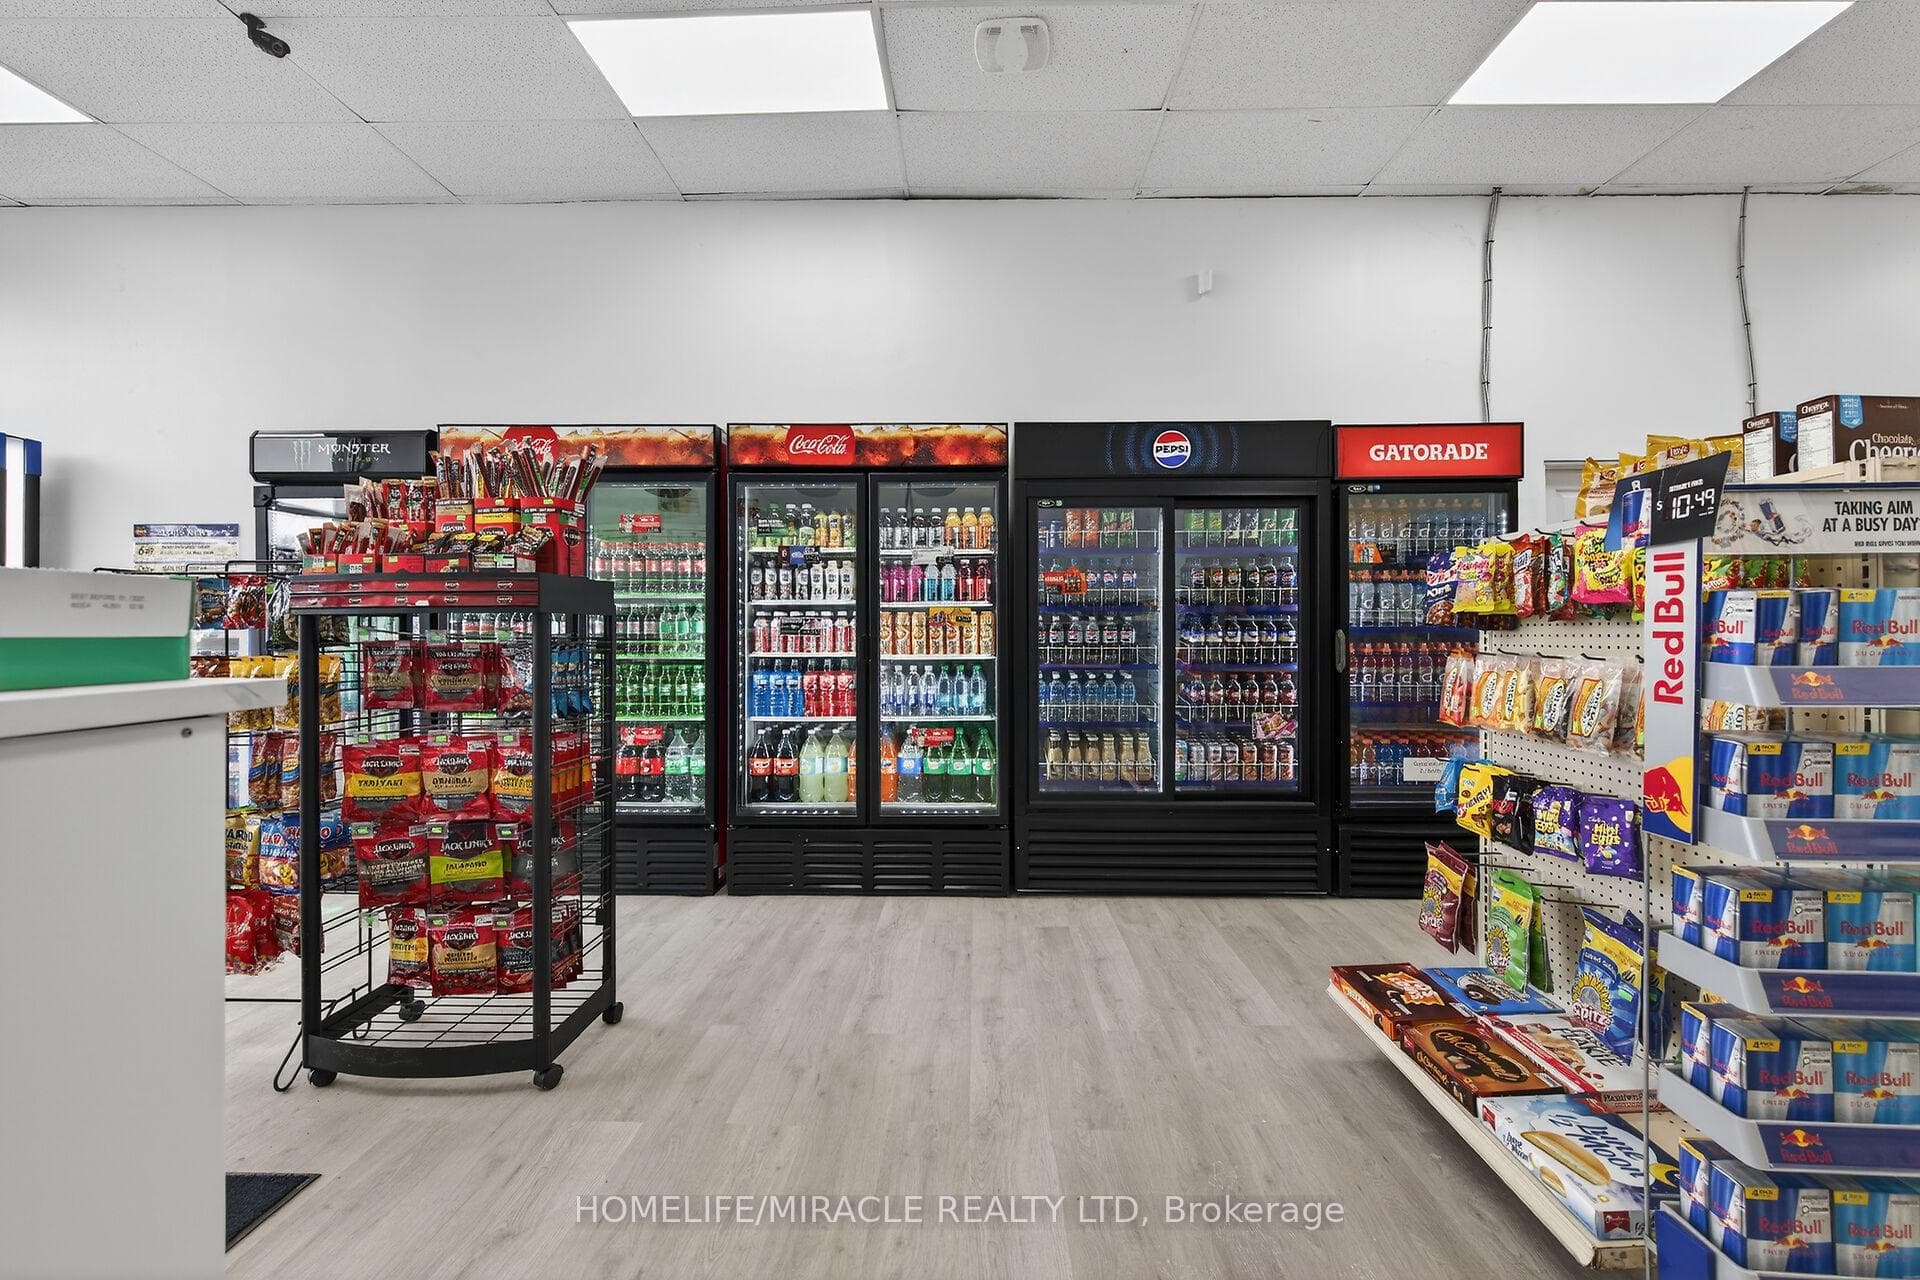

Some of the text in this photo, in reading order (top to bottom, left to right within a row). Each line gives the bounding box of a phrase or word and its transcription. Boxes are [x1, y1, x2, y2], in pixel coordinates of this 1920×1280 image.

[318, 443, 391, 455] MONSTER
[789, 433, 850, 455] Coca-Cola
[1156, 444, 1189, 454] PEPSI
[1369, 443, 1489, 461] GATORADE
[1672, 488, 1716, 520] 10.49
[1834, 500, 1913, 515] TAKING AIM
[1822, 518, 1838, 532] AT
[1842, 518, 1852, 532] A
[1855, 517, 1889, 532] BUSY
[1652, 551, 1685, 704] Red Bull
[1717, 620, 1744, 634] Bull
[1853, 619, 1918, 634] Red Bull
[1760, 772, 1823, 787] Red Bull
[1847, 773, 1911, 788] Red Bull
[1752, 921, 1814, 934] Red Bull
[1840, 922, 1904, 936] Red Bull
[1752, 1041, 1760, 1049] 4
[1759, 1070, 1824, 1086] Red Bull
[1846, 1072, 1911, 1087] Red Bull
[1759, 1217, 1822, 1234] Red Bull
[1848, 1222, 1913, 1239] Red Bull
